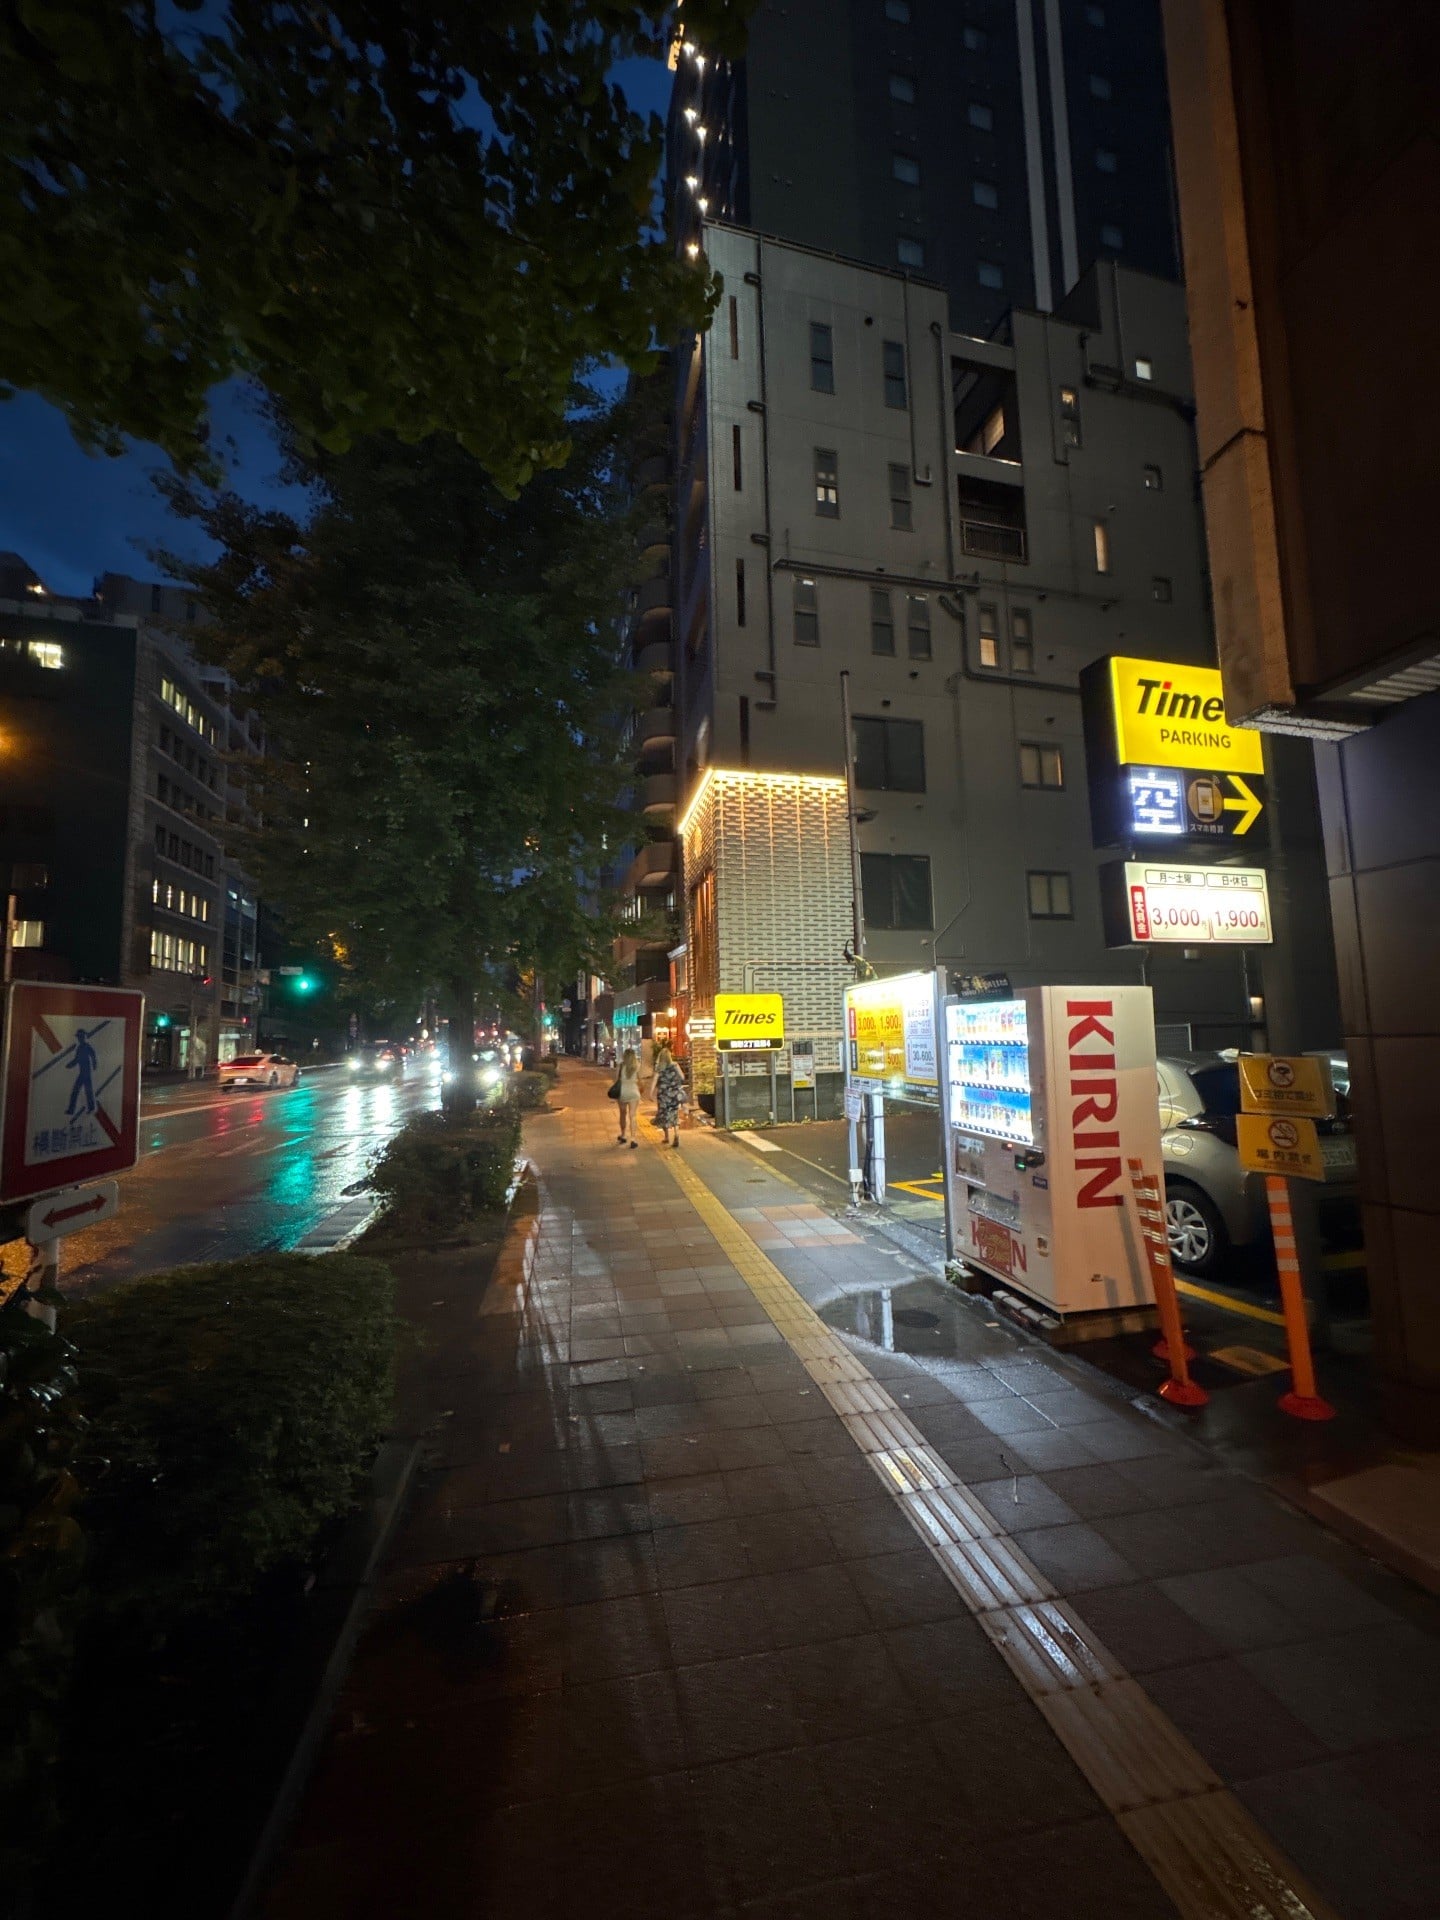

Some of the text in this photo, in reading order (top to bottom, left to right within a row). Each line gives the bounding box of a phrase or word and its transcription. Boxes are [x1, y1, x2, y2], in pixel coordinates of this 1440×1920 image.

[1138, 679, 1224, 722] Time
[1160, 729, 1231, 748] PARKING
[1131, 773, 1182, 834] 空
[725, 1010, 777, 1025] Times
[1067, 1001, 1124, 1208] KIRIN
